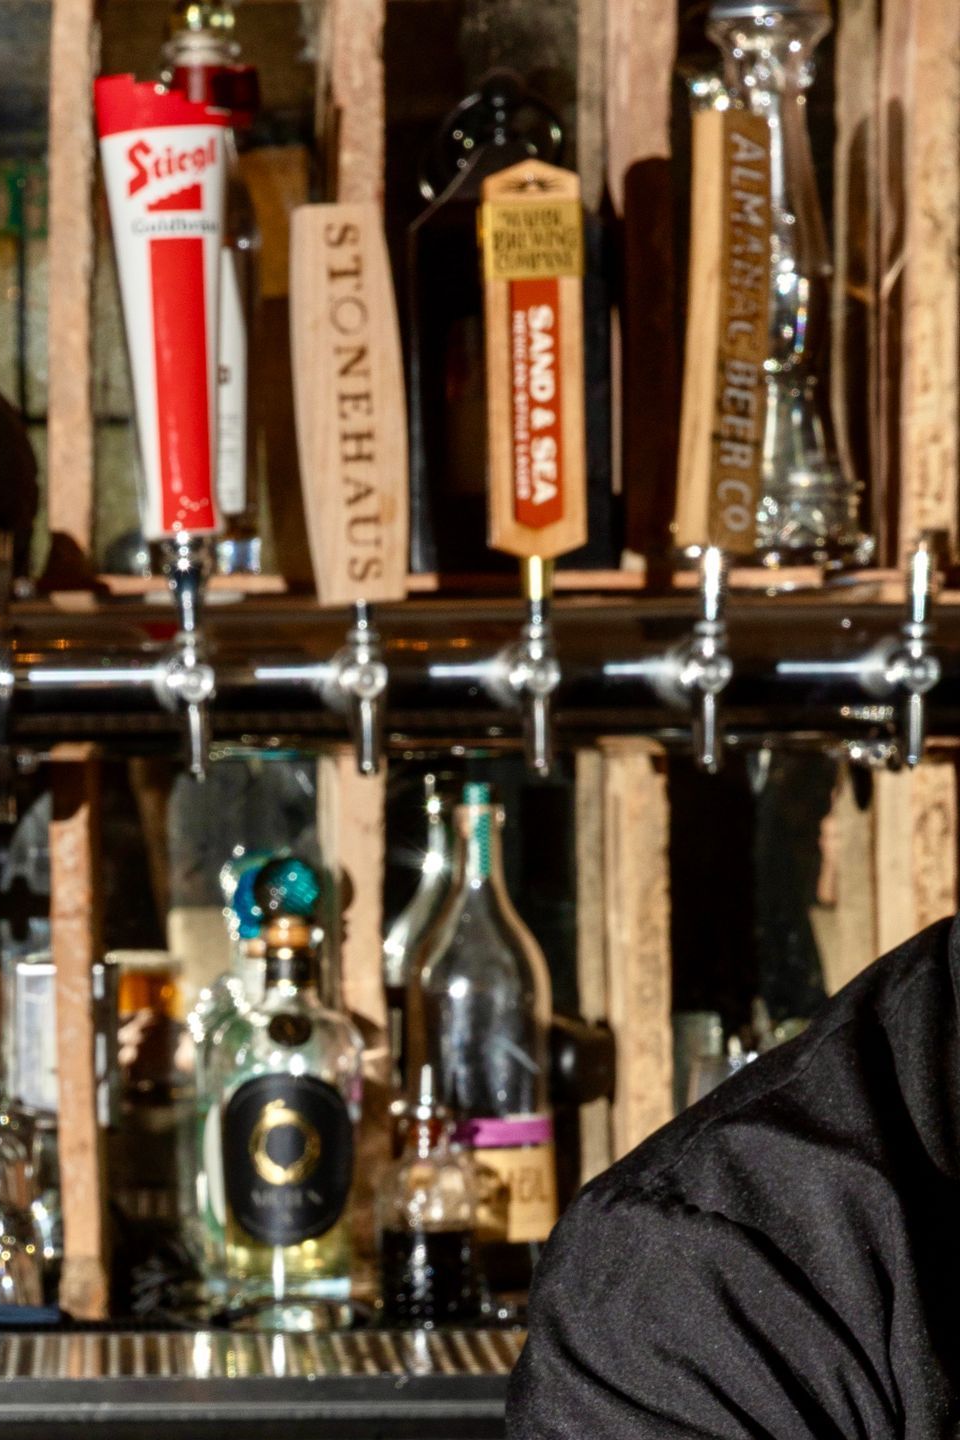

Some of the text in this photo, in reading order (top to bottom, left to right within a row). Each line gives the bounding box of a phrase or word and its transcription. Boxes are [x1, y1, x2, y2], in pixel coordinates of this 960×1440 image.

[126, 139, 217, 198] Stiegl
[527, 304, 556, 403] SAND
[717, 132, 766, 532] ALMANAC BEER CO
[324, 222, 385, 584] STONEHAUS
[530, 435, 559, 506] SEA
